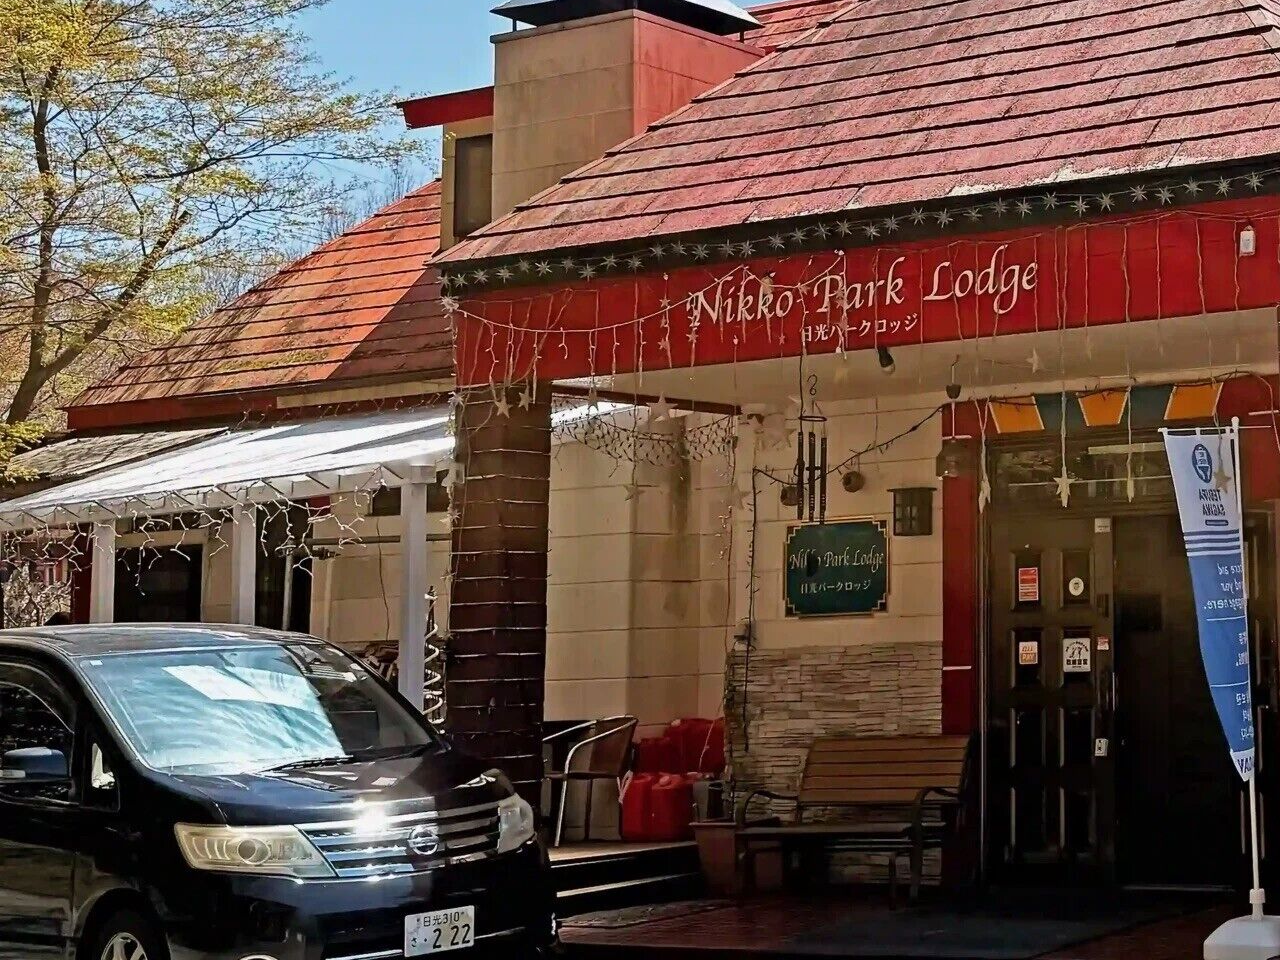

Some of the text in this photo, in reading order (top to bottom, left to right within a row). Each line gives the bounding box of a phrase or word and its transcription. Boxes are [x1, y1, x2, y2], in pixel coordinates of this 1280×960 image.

[686, 244, 1038, 326] Nikko Park Lodge
[825, 546, 850, 567] Park
[853, 544, 884, 573] Lodge
